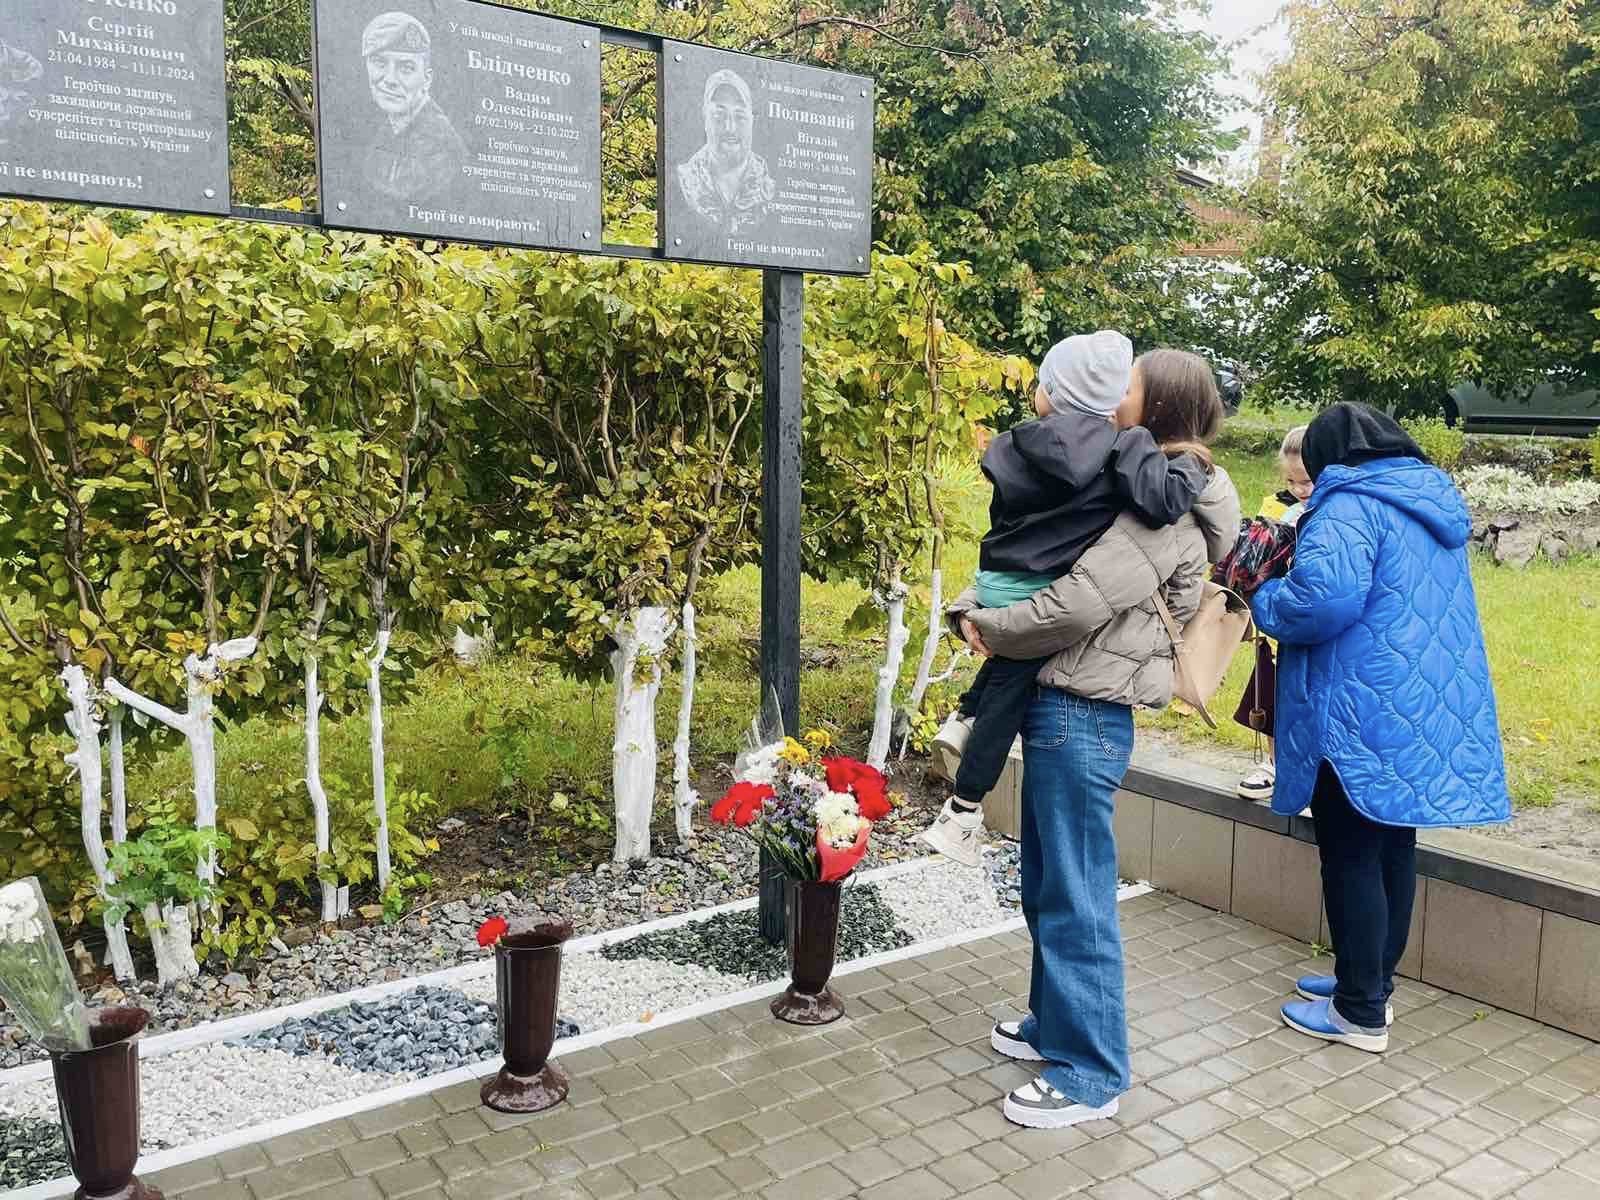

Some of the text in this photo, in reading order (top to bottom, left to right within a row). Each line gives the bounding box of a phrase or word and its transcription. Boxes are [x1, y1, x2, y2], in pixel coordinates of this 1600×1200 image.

[87, 15, 155, 40] Сергій
[448, 21, 459, 33] У
[56, 29, 186, 63] Михайлович
[132, 62, 195, 81] 11.11.2024
[466, 49, 571, 86] Блідченко
[63, 75, 178, 105] Героїчно загинув,
[504, 86, 551, 105] Вадим
[48, 94, 192, 121] захищаючи державний
[481, 98, 574, 124] Олексійович
[767, 101, 856, 130] Поливаний
[28, 108, 213, 142] суверенітет та територіальну
[797, 131, 839, 149] Віталій
[15, 165, 37, 179] не
[41, 168, 144, 189] вмирають!
[408, 205, 541, 232] Герої не вмирають!
[727, 239, 755, 254] Герої
[771, 245, 826, 259] вмирають!
